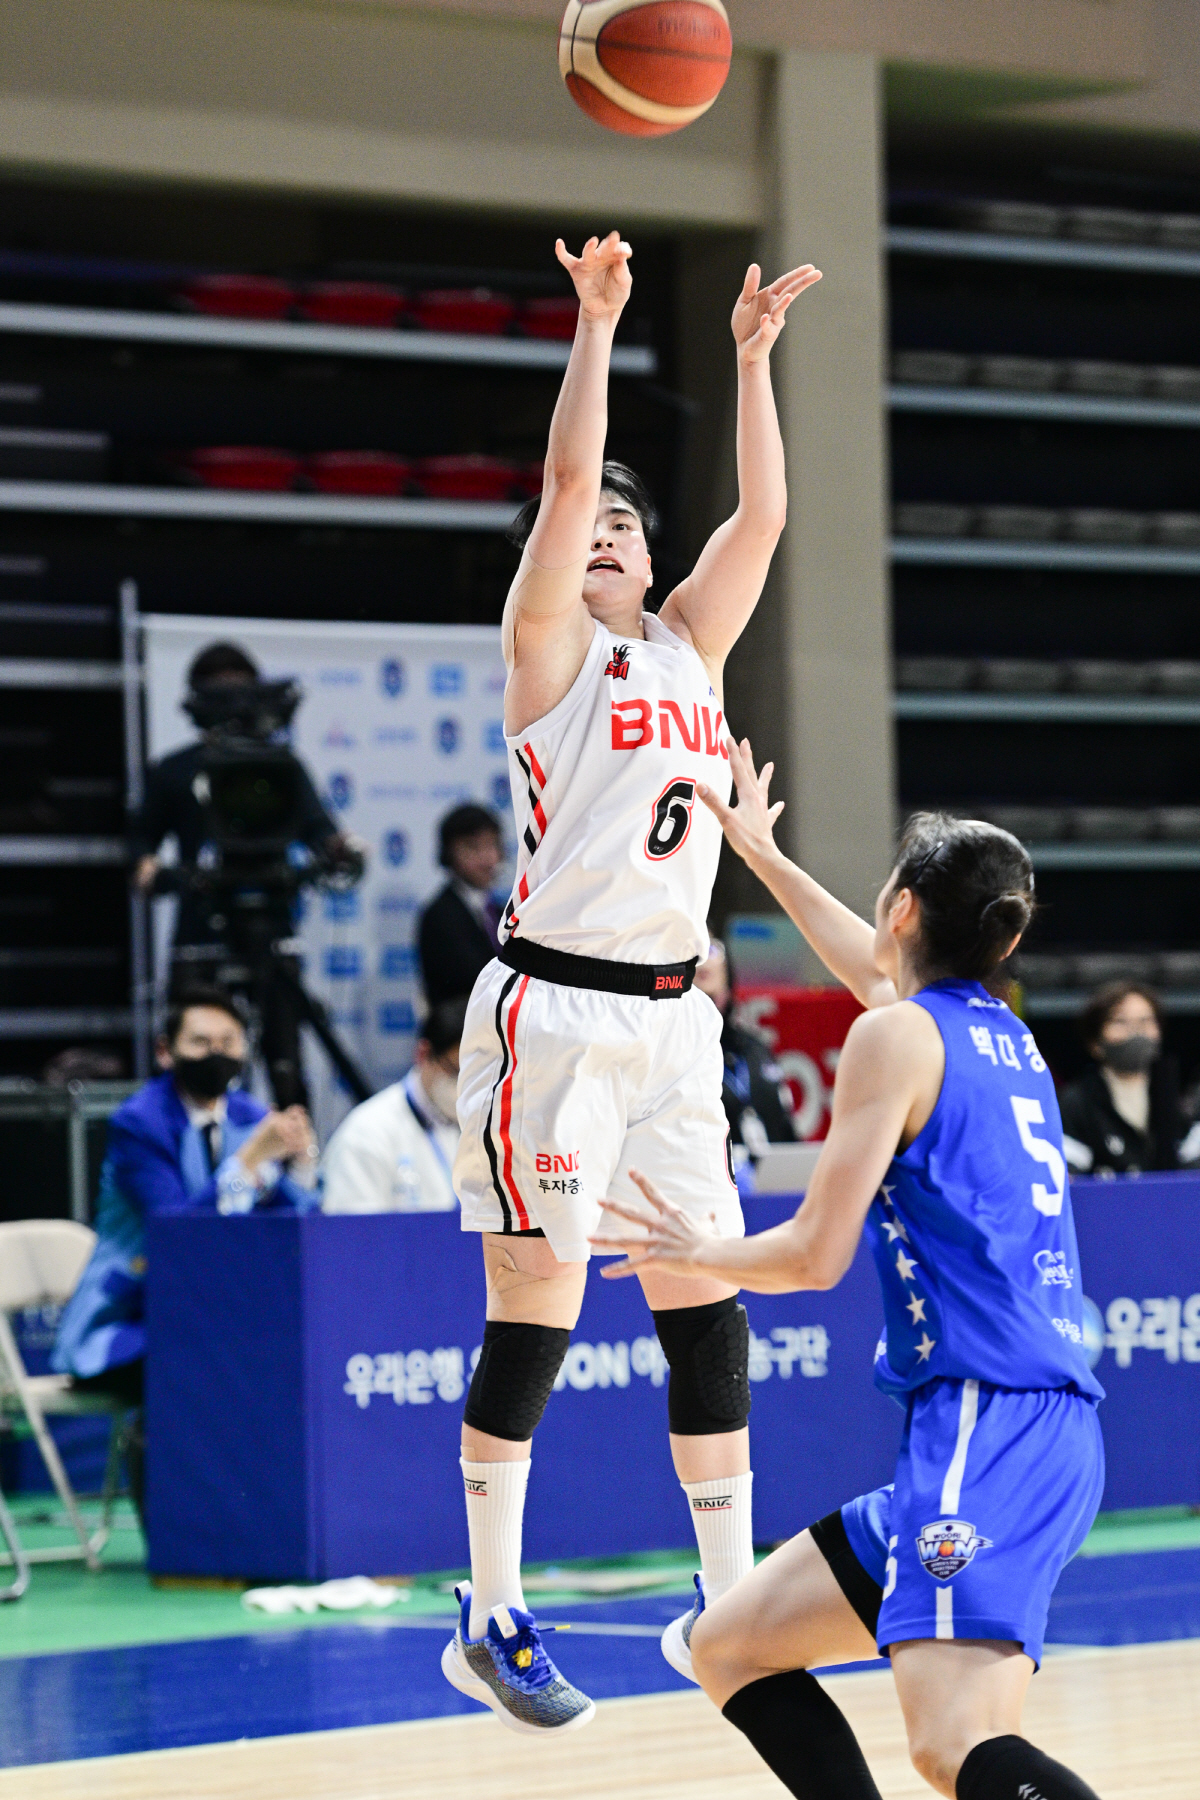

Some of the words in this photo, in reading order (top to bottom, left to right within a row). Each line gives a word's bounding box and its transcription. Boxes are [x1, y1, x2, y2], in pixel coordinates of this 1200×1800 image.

[611, 698, 729, 760] BNK
[644, 776, 697, 861] 6
[655, 975, 684, 990] BNK
[538, 1177, 584, 1195] 투자증
[1009, 1095, 1066, 1217] 5
[343, 1346, 465, 1409] 우리은행
[692, 1498, 732, 1508] BNK
